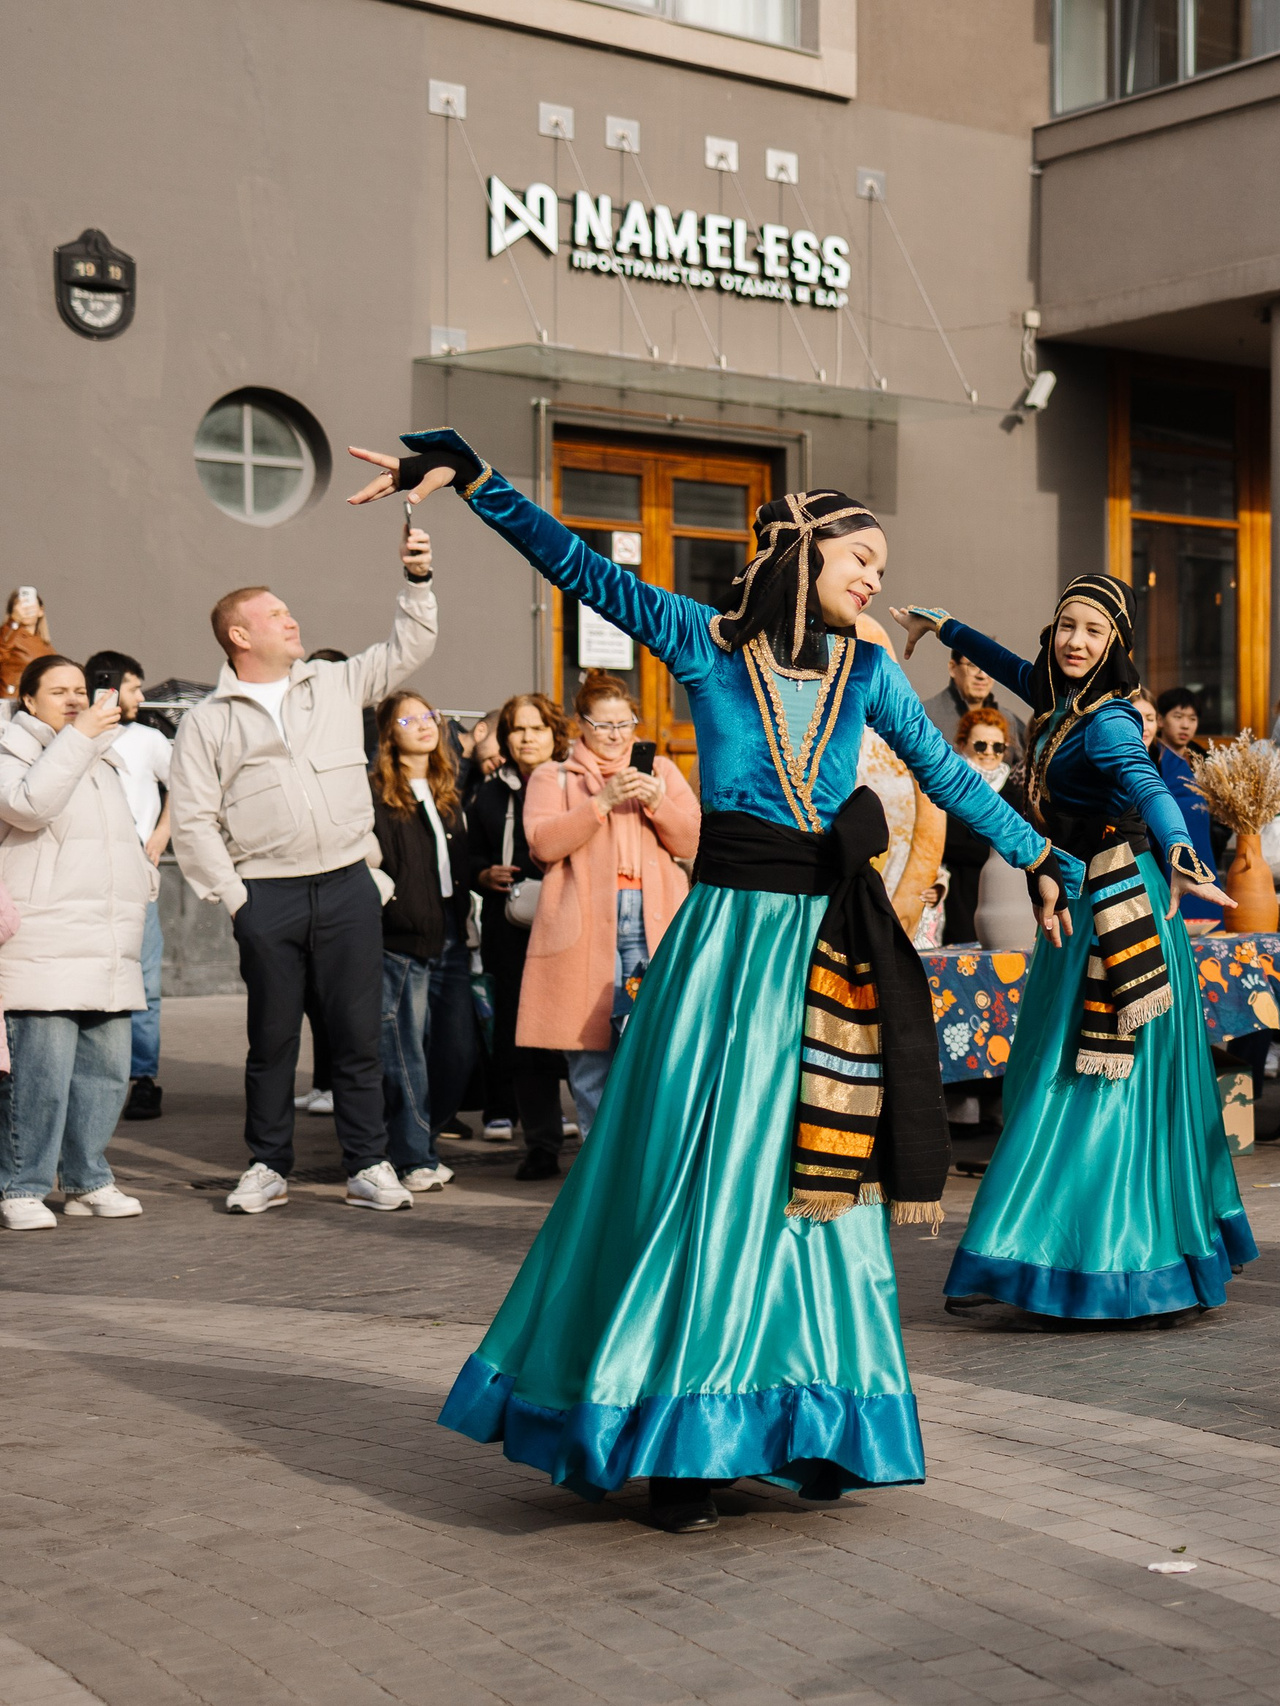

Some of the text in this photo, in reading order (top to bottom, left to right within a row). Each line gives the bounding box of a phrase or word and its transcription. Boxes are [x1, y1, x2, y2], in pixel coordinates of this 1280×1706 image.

[575, 190, 851, 289] NAMELESS
[75, 261, 96, 277] 19
[572, 250, 715, 287] ПРОСТРАНСТВО
[719, 272, 793, 301] ОТДЫХА
